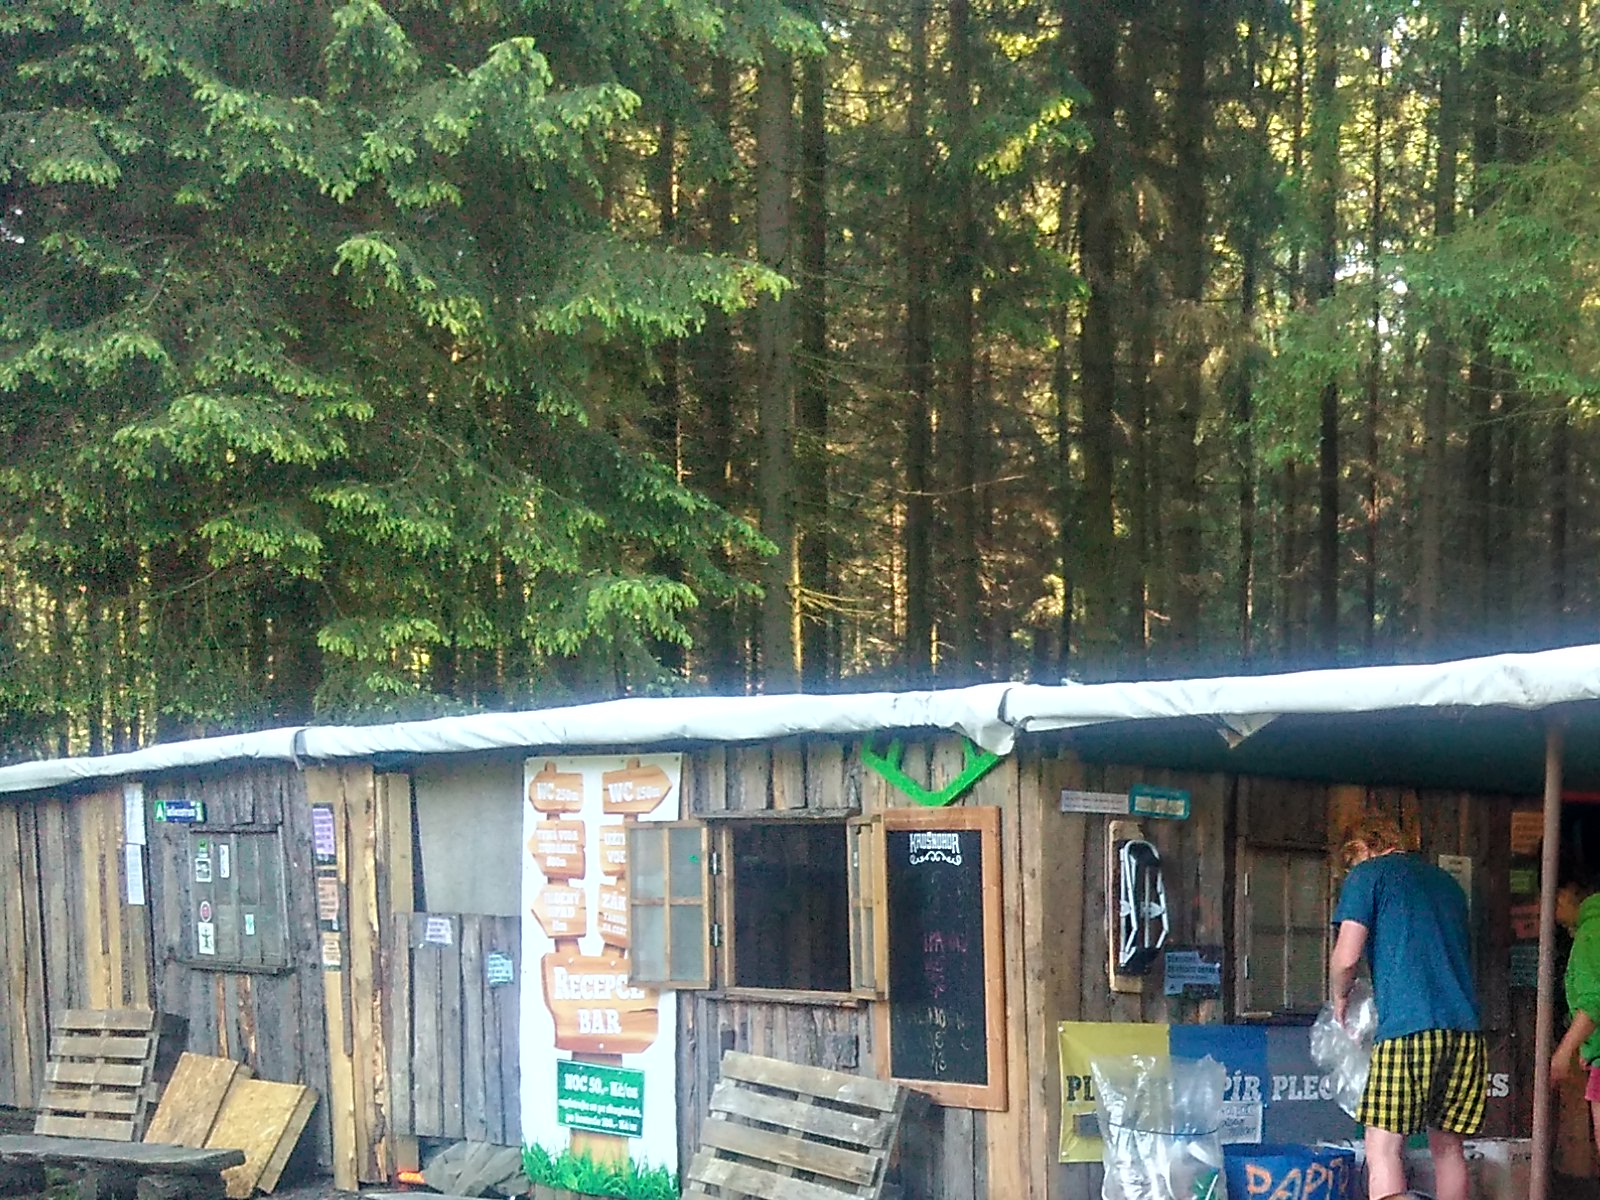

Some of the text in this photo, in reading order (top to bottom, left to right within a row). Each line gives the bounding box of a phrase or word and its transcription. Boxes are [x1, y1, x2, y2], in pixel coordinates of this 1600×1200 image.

[537, 782, 555, 801] WC
[608, 781, 634, 803] WC
[578, 1008, 621, 1034] BAR
[564, 1073, 588, 1093] NOC
[1272, 1075, 1335, 1101] PLEC
